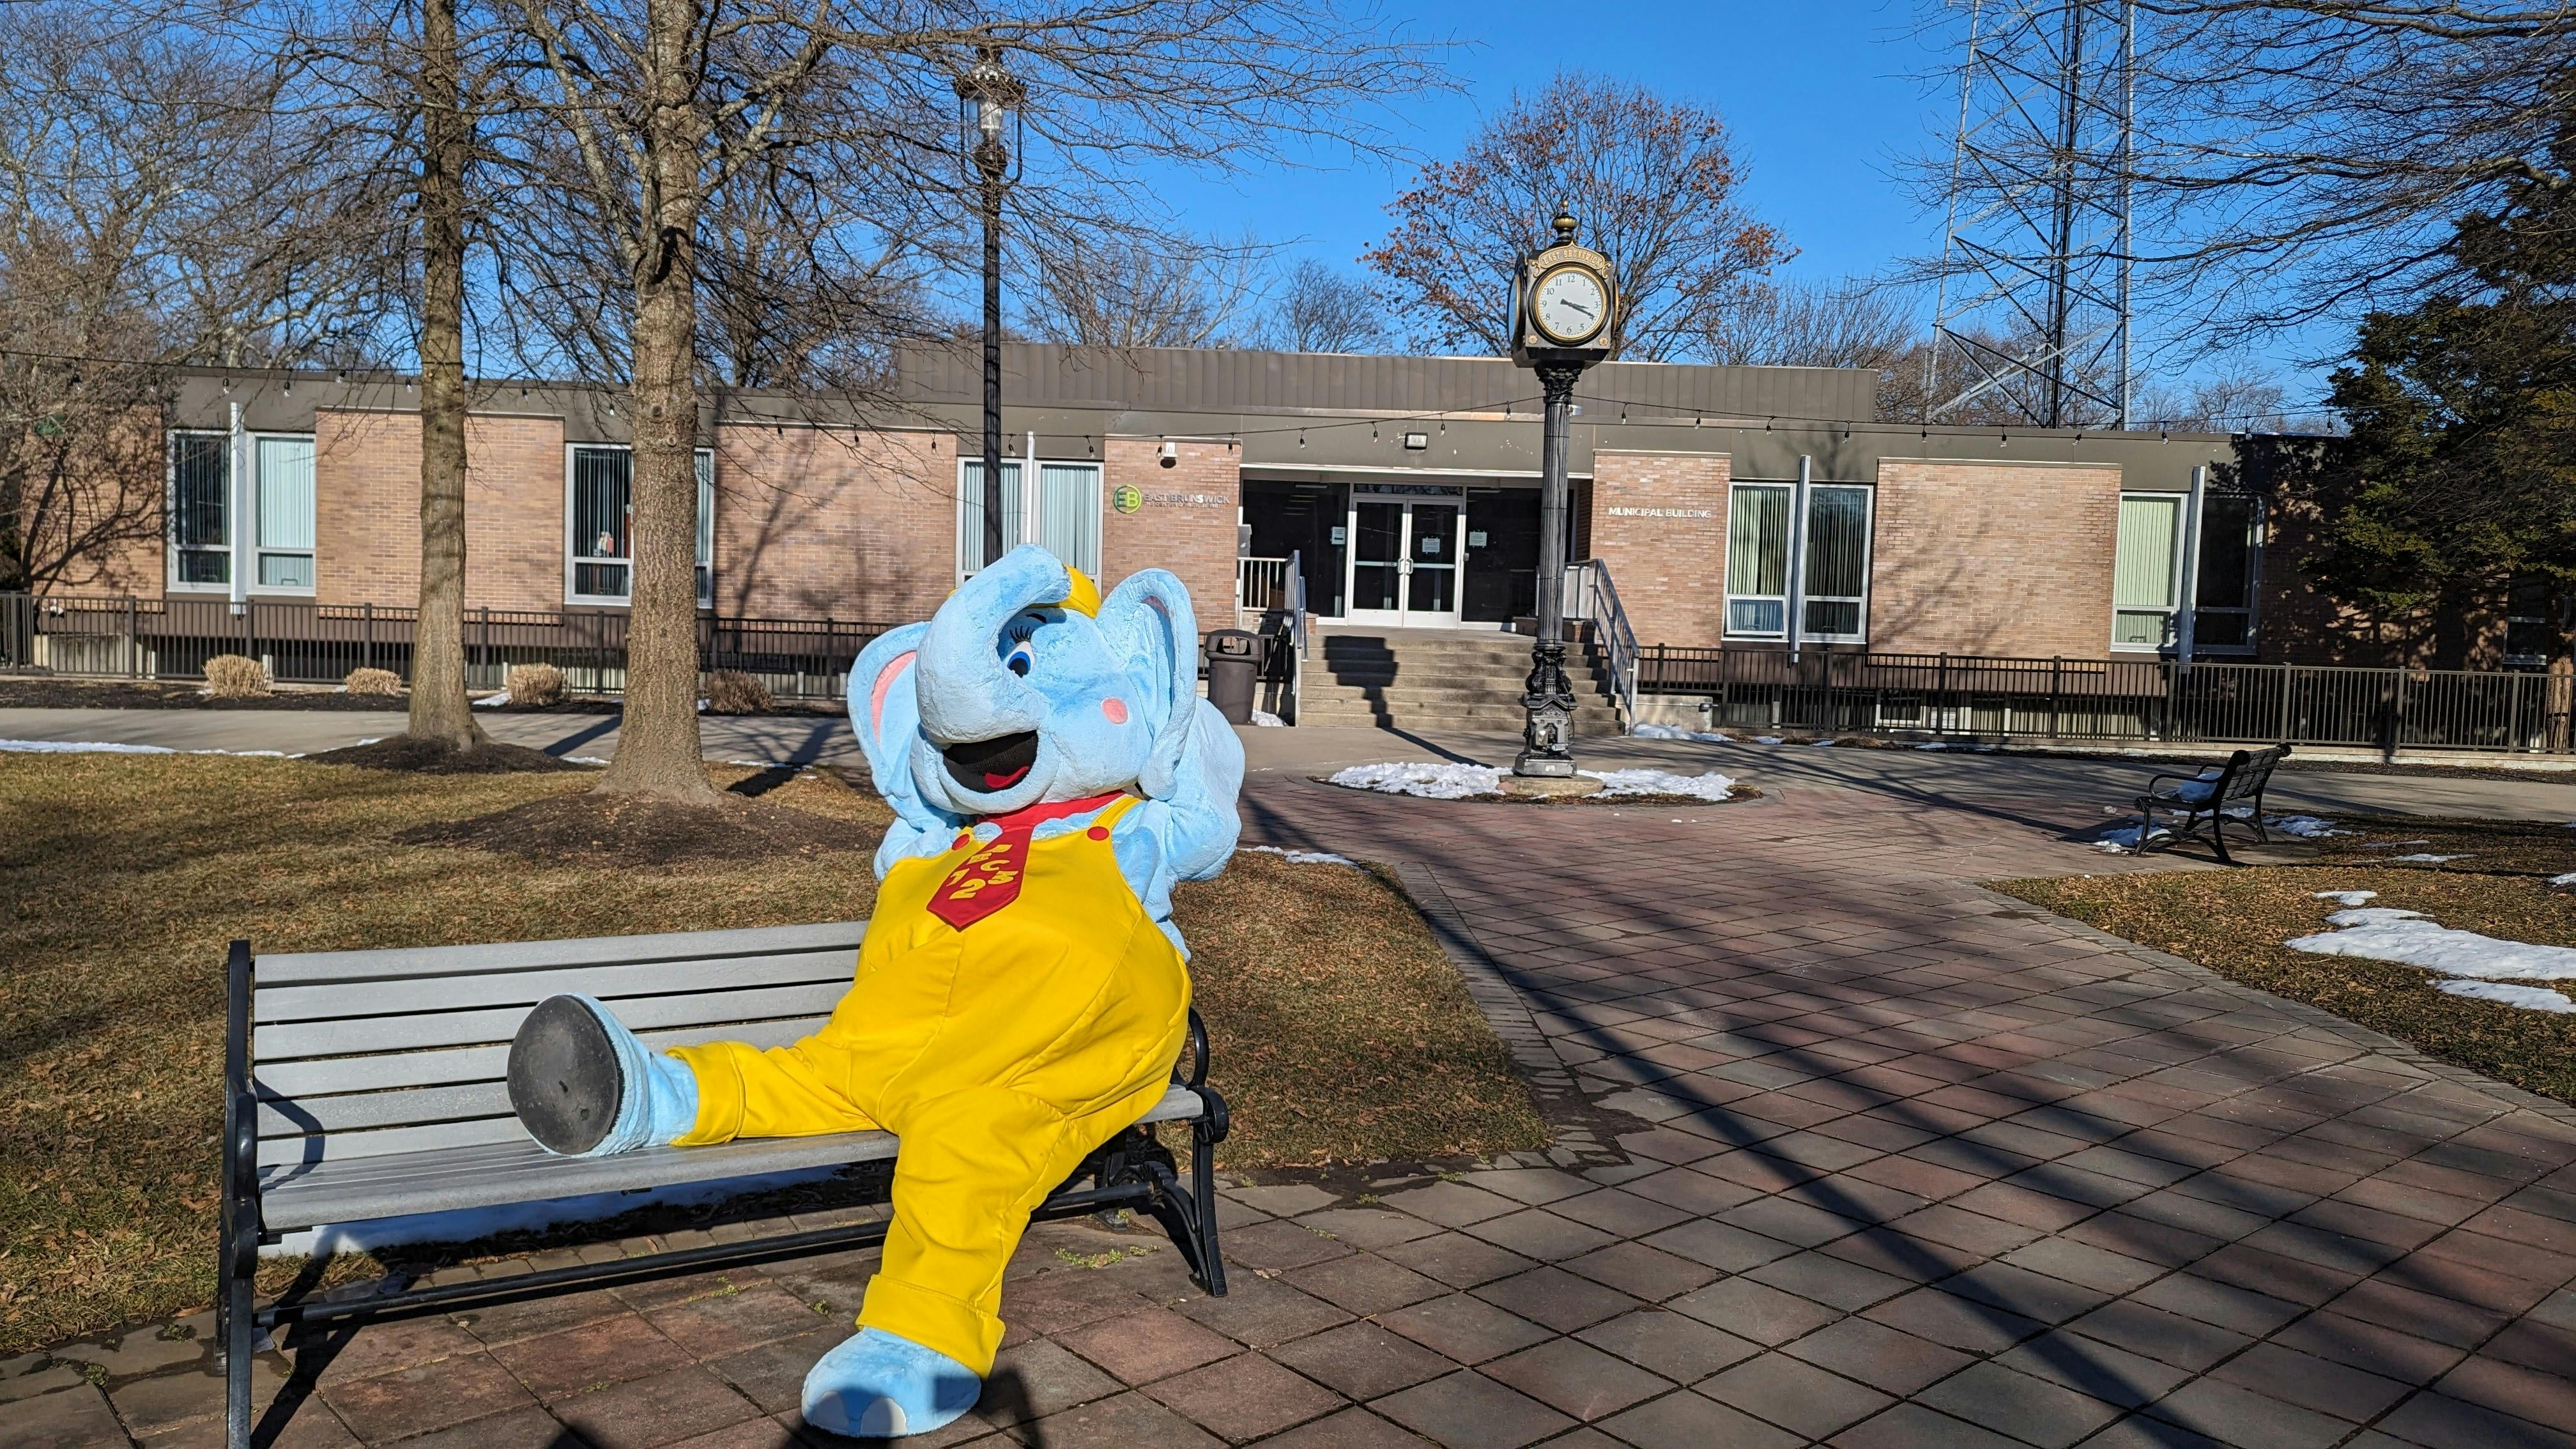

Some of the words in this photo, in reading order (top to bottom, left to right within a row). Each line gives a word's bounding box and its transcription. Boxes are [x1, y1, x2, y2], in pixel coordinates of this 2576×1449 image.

[1542, 252, 1560, 265] EAST
[1563, 250, 1602, 266] BRUNSWICK
[1170, 494, 1230, 504] BRUNSWICK
[1608, 507, 1664, 517] MUNICIPAL
[1666, 508, 1712, 519] BUILDING
